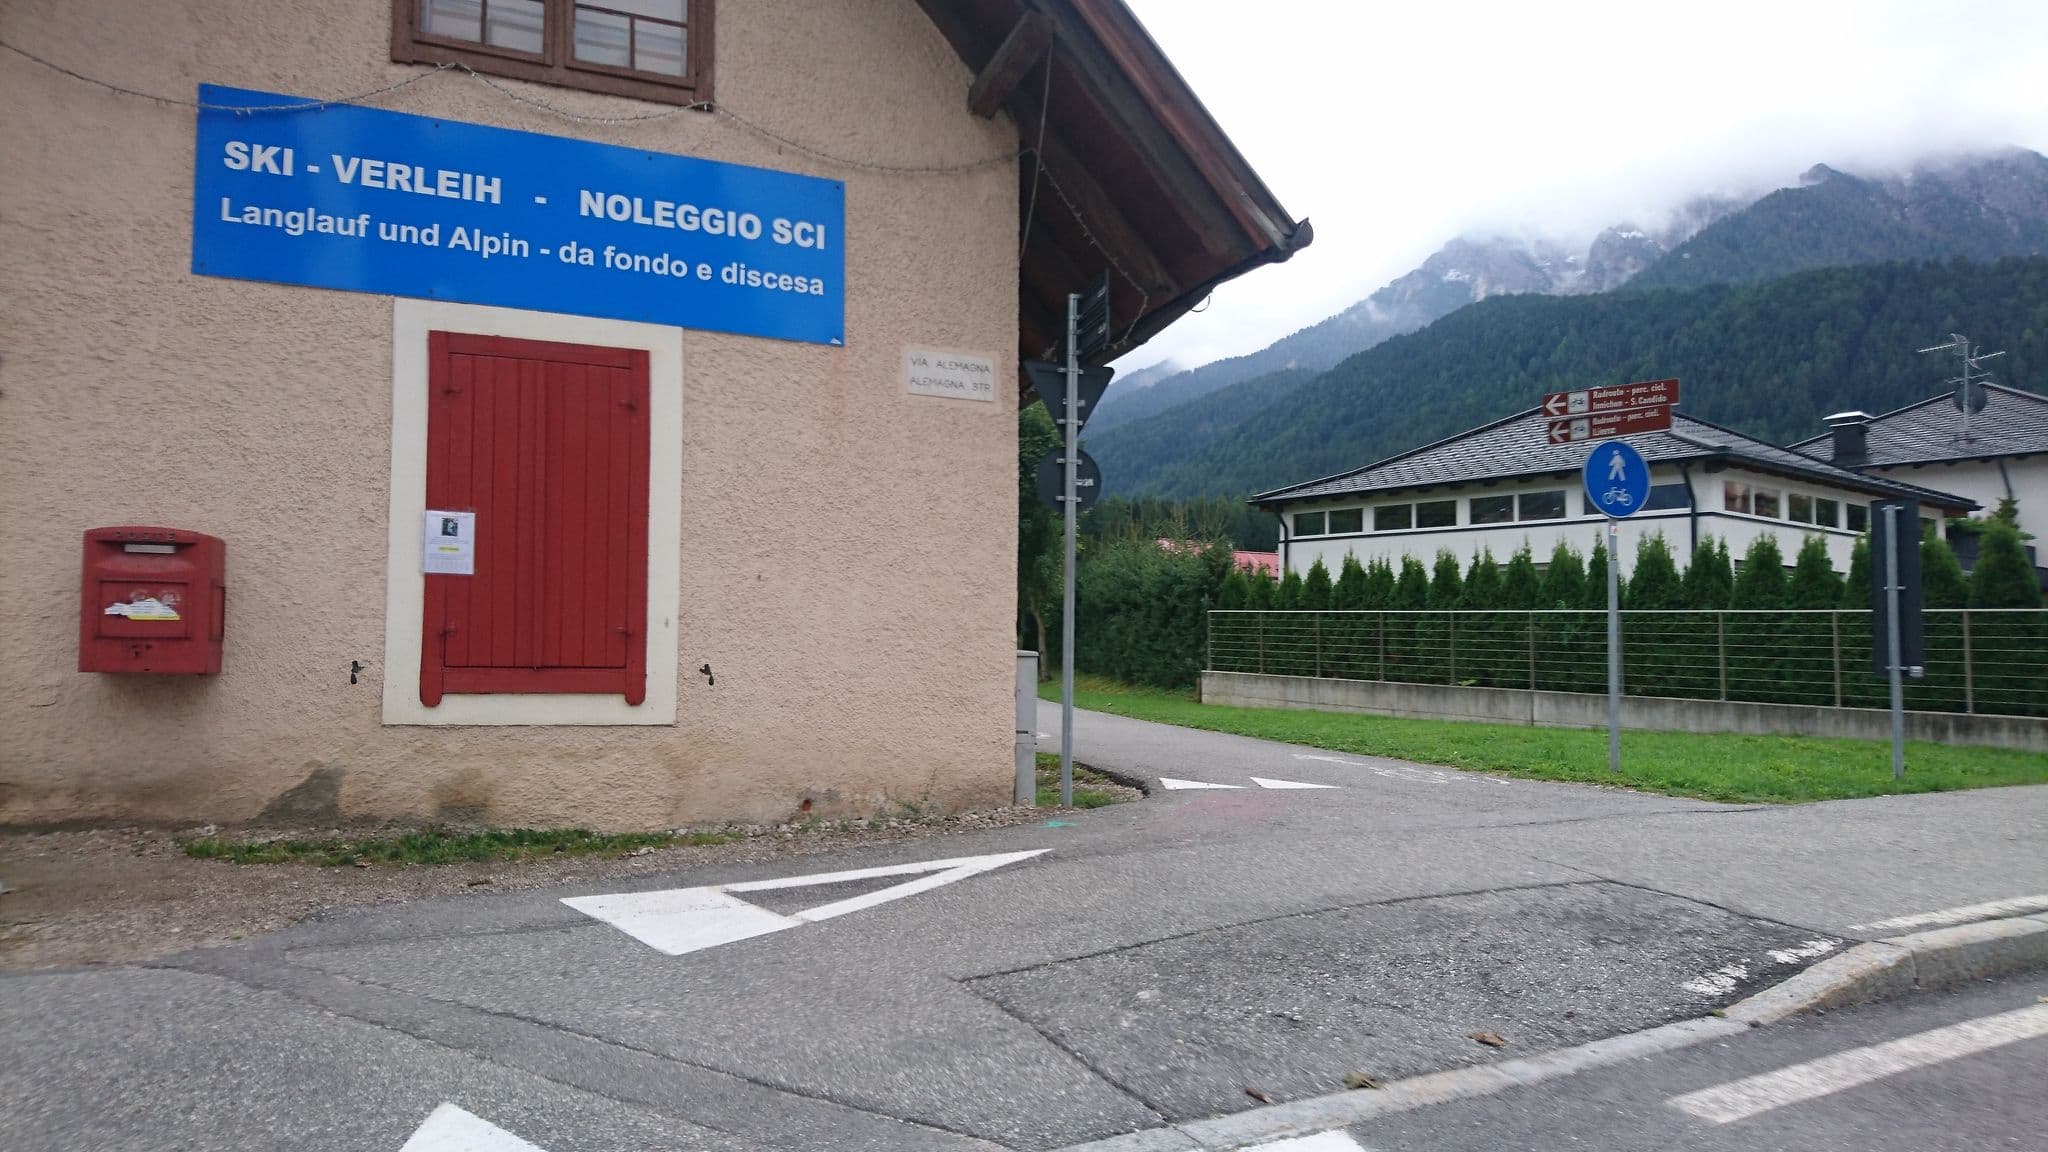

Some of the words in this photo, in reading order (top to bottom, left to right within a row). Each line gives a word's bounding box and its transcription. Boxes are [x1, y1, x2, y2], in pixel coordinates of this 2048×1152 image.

[223, 141, 294, 177] SKI
[307, 164, 320, 174] -
[332, 154, 501, 205] VERLEIH
[534, 196, 547, 204] -
[579, 189, 762, 241] NOLEGGIO
[772, 217, 826, 250] SCI
[220, 197, 371, 237] Langlauf
[379, 222, 440, 247] und
[448, 226, 530, 260] Alpin
[539, 247, 550, 255] -
[559, 241, 594, 267] da
[603, 245, 688, 279] fondo
[696, 263, 713, 281] e
[721, 262, 825, 296] discesa
[911, 357, 929, 367] VIA
[936, 360, 991, 374] ALEMAGNA
[911, 376, 965, 390] ALEMAGNA
[1593, 389, 1624, 399] Radroute
[1638, 394, 1667, 404] Candido
